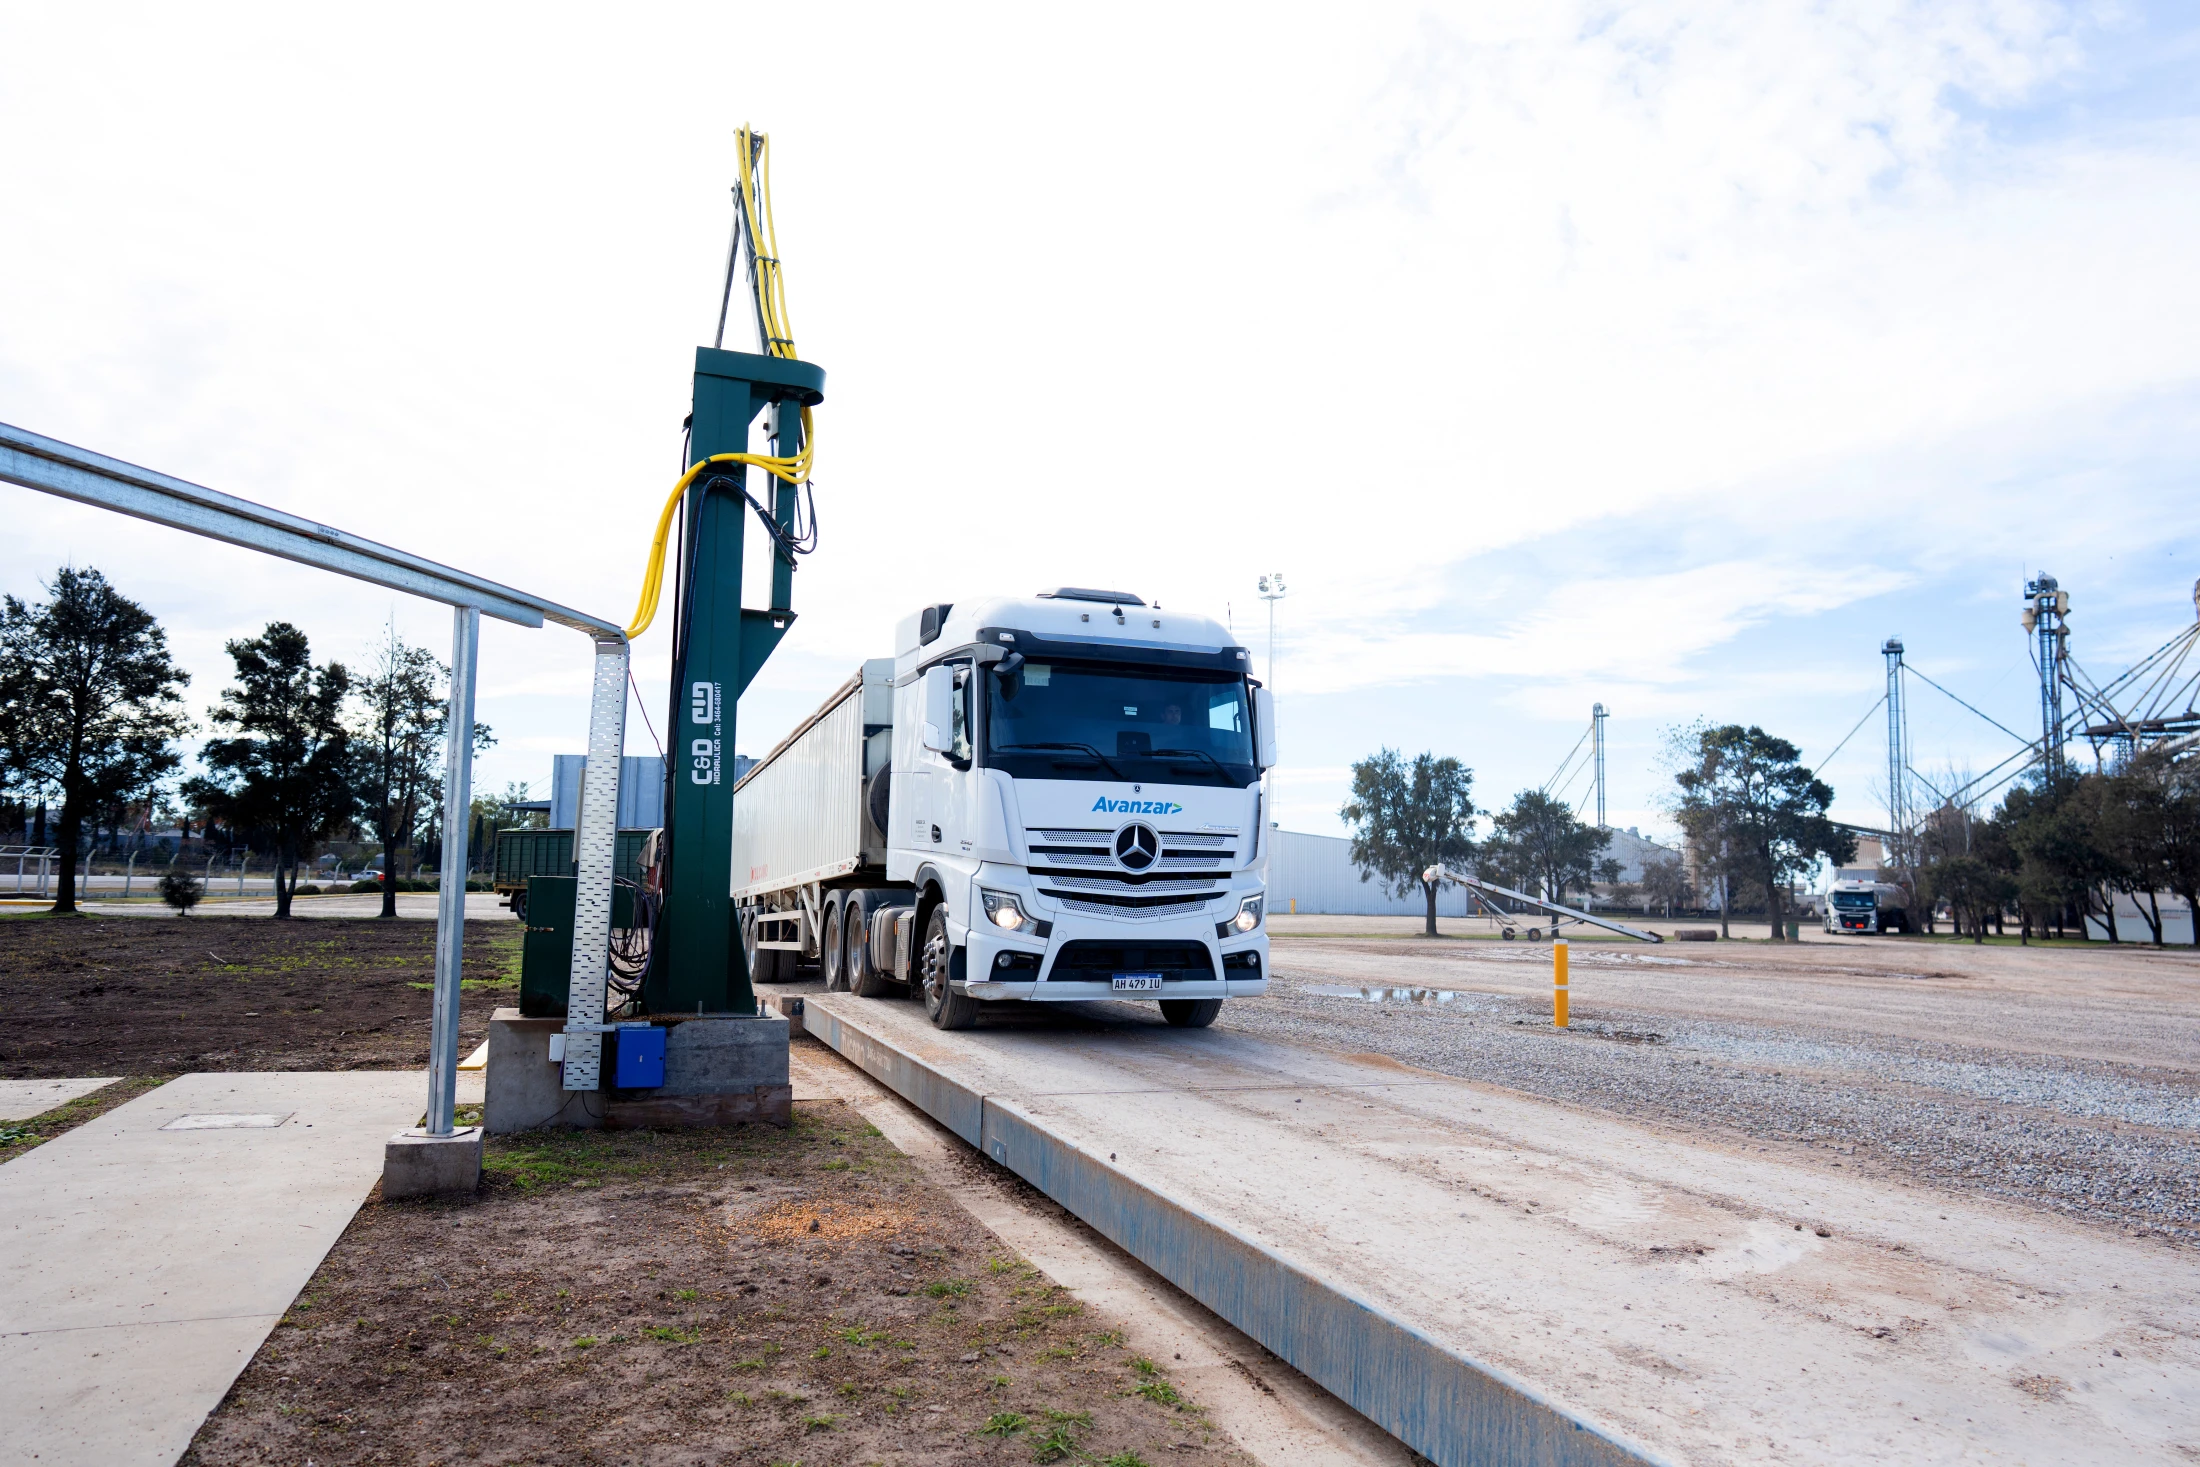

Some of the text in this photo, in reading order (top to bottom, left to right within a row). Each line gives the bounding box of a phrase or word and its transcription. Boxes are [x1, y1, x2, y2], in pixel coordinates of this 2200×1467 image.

[692, 739, 713, 785] C&D
[713, 739, 721, 785] HIDRAULICA
[1091, 796, 1173, 815] Avanzar
[1114, 979, 1160, 989] AH 479 IU
